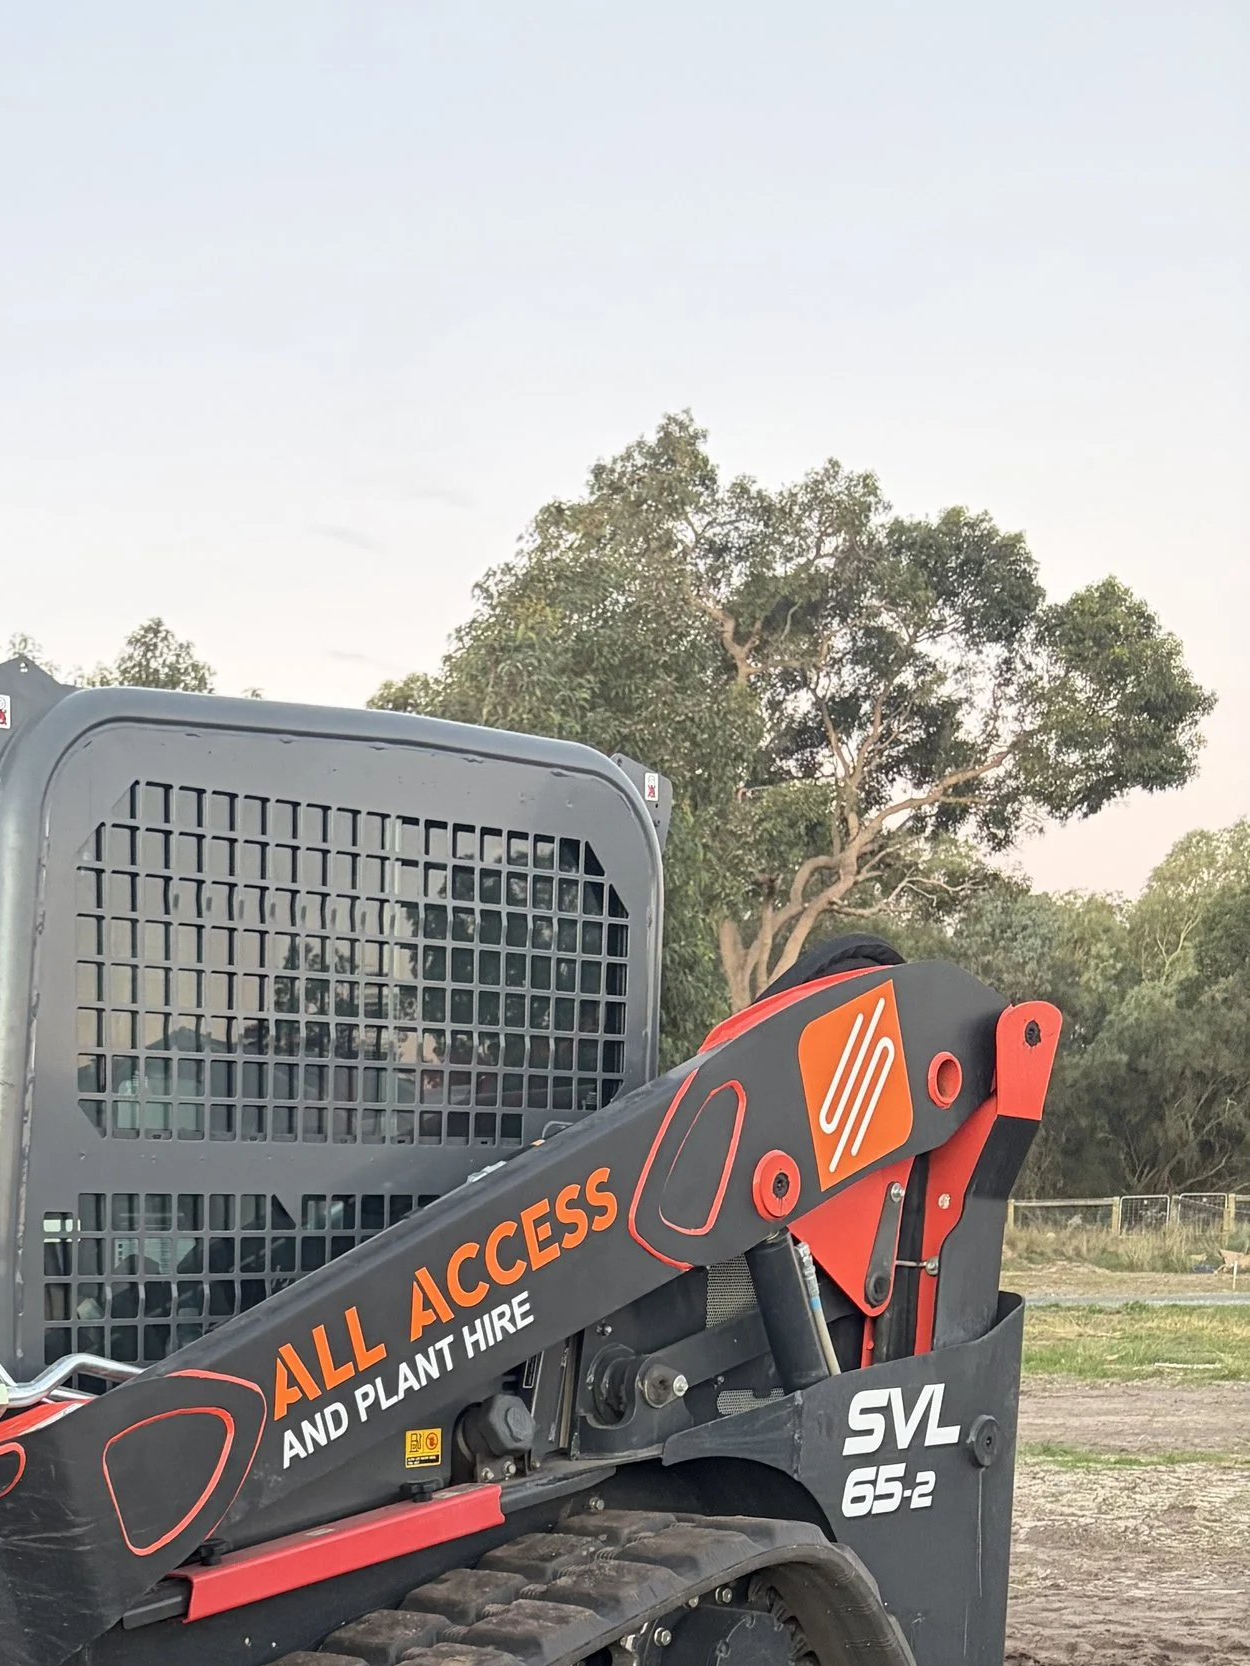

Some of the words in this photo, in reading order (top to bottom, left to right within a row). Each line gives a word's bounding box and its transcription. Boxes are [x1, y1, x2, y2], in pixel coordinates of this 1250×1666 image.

[274, 1307, 387, 1421] ALL
[410, 1167, 618, 1342] ACCESS
[282, 1401, 349, 1469] AND
[354, 1334, 454, 1422] PLANT
[461, 1290, 535, 1359] HIRE
[842, 1383, 961, 1456] SVL
[841, 1463, 936, 1518] 65-2
